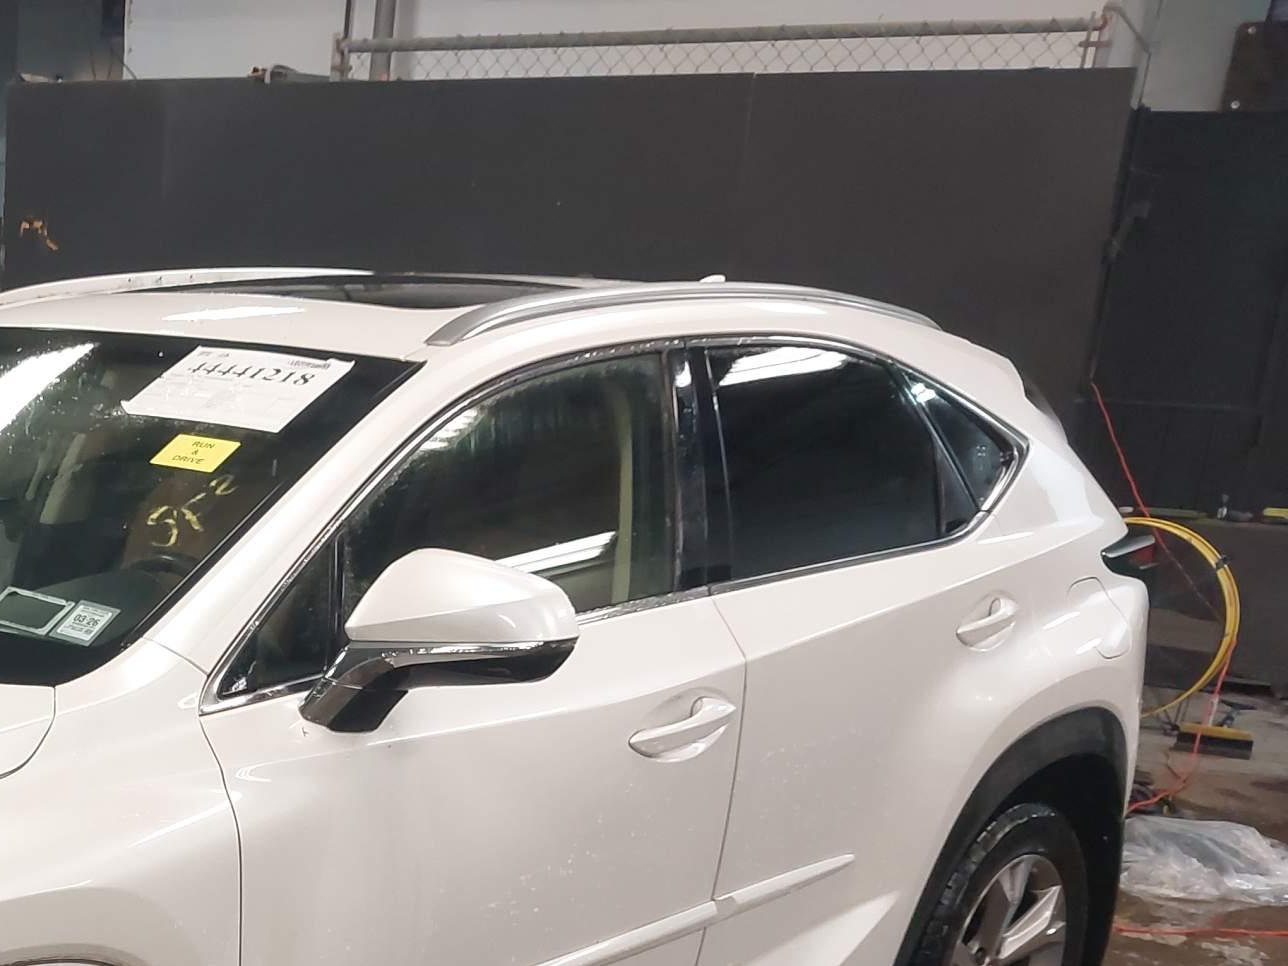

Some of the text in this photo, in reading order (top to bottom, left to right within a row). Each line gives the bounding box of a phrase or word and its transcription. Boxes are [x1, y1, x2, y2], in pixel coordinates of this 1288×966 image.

[187, 361, 315, 387] 44441218
[191, 441, 216, 450] RUN
[171, 455, 206, 465] DRIVE
